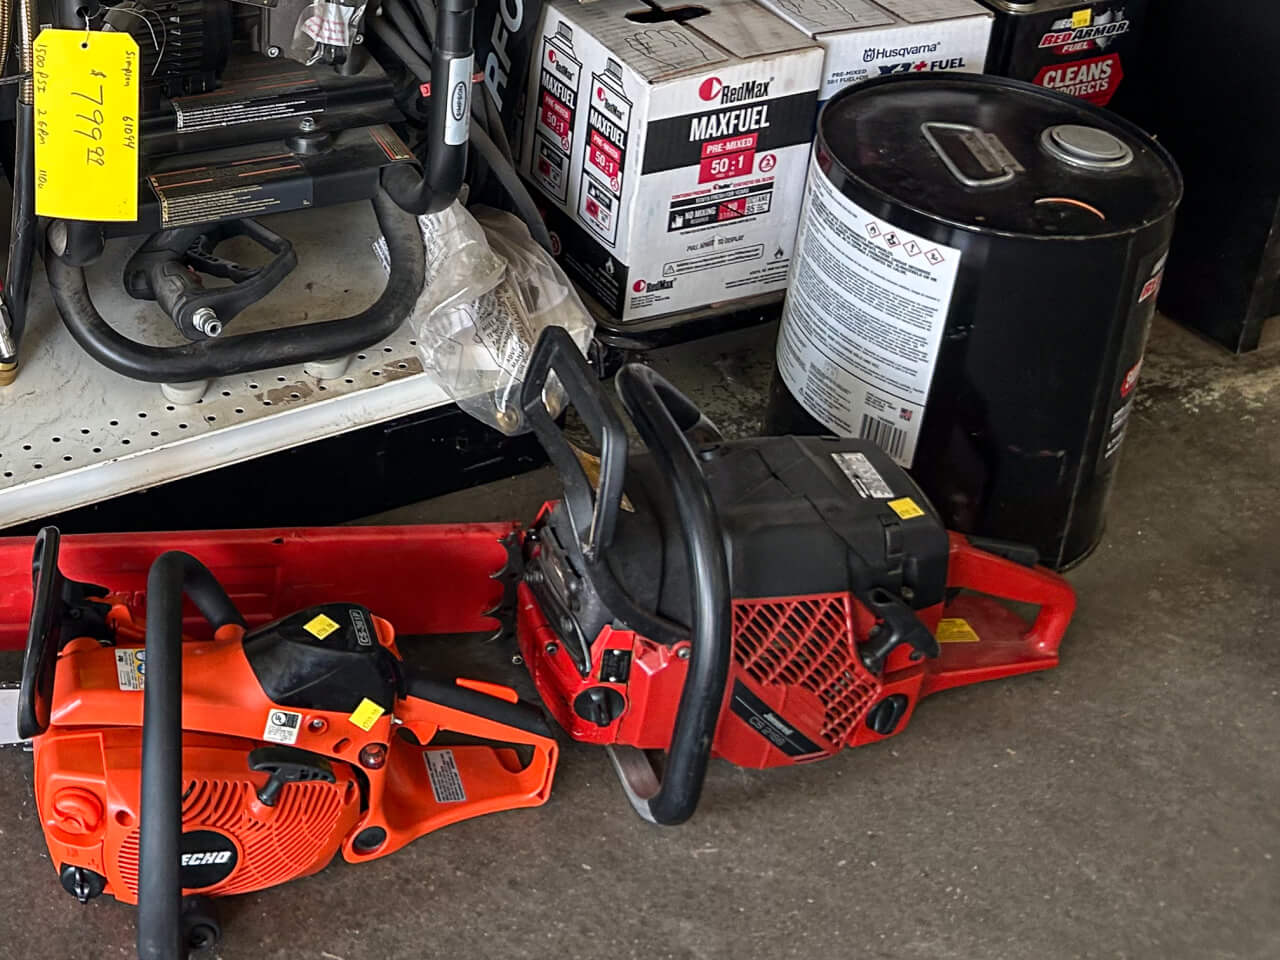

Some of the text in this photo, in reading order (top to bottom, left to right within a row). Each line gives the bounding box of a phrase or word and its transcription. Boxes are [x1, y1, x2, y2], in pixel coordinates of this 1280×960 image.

[875, 43, 937, 64] Husqvarna
[1062, 42, 1088, 53] FUEL
[930, 57, 966, 72] FUEL
[1043, 60, 1112, 89] CLEANS
[542, 71, 575, 109] MAXFUEL
[721, 80, 769, 105] RedMax
[590, 108, 625, 149] MAXFUEL
[689, 105, 769, 141] MAXFUEL
[706, 138, 753, 154] PRE-MIXED
[594, 150, 613, 173] 50:1
[182, 850, 232, 866] ECHO
